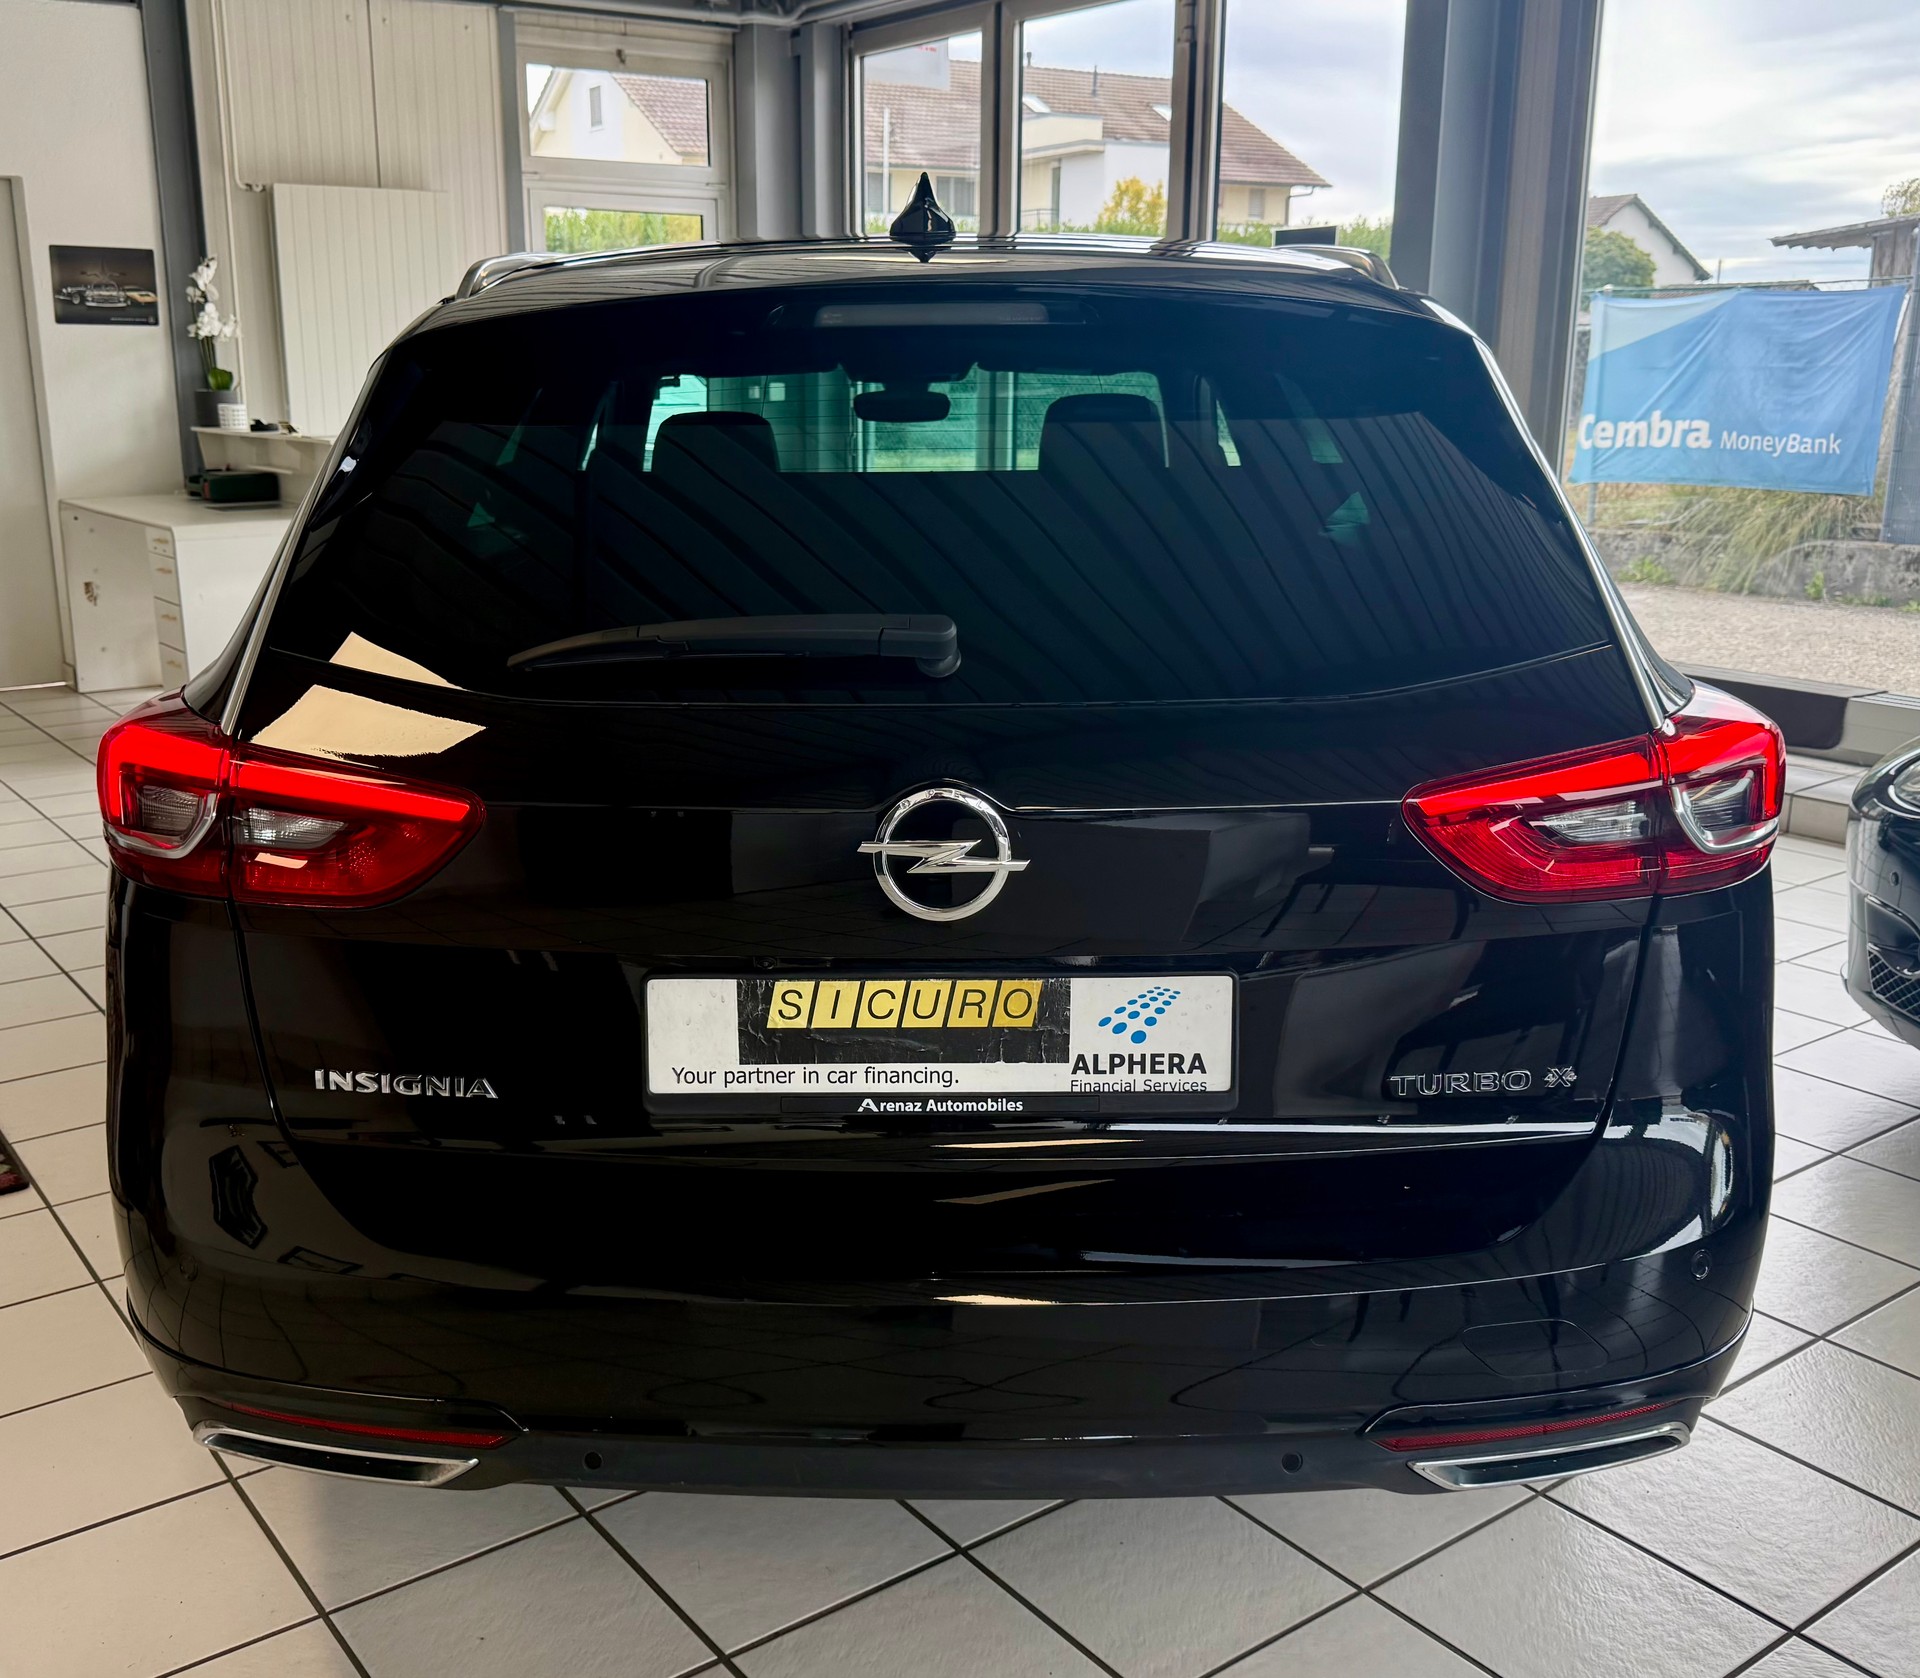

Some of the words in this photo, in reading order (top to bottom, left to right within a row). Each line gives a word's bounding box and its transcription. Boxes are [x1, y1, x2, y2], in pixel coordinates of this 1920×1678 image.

[1578, 409, 1712, 449] Cembra
[1720, 430, 1842, 458] MoneyBank
[777, 988, 1034, 1020] SICURO
[1070, 1053, 1207, 1075] ALPHERA
[314, 1069, 499, 1099] INSIGNIA
[672, 1067, 716, 1085] Your
[724, 1068, 795, 1088] partner
[803, 1067, 819, 1084] in
[827, 1070, 857, 1084] car
[865, 1066, 960, 1087] financing.
[1070, 1079, 1137, 1092] Financial
[1143, 1079, 1207, 1092] Services
[1389, 1069, 1532, 1095] TURBO
[857, 1098, 922, 1113] Arenaz
[926, 1098, 1024, 1113] Automobiles
